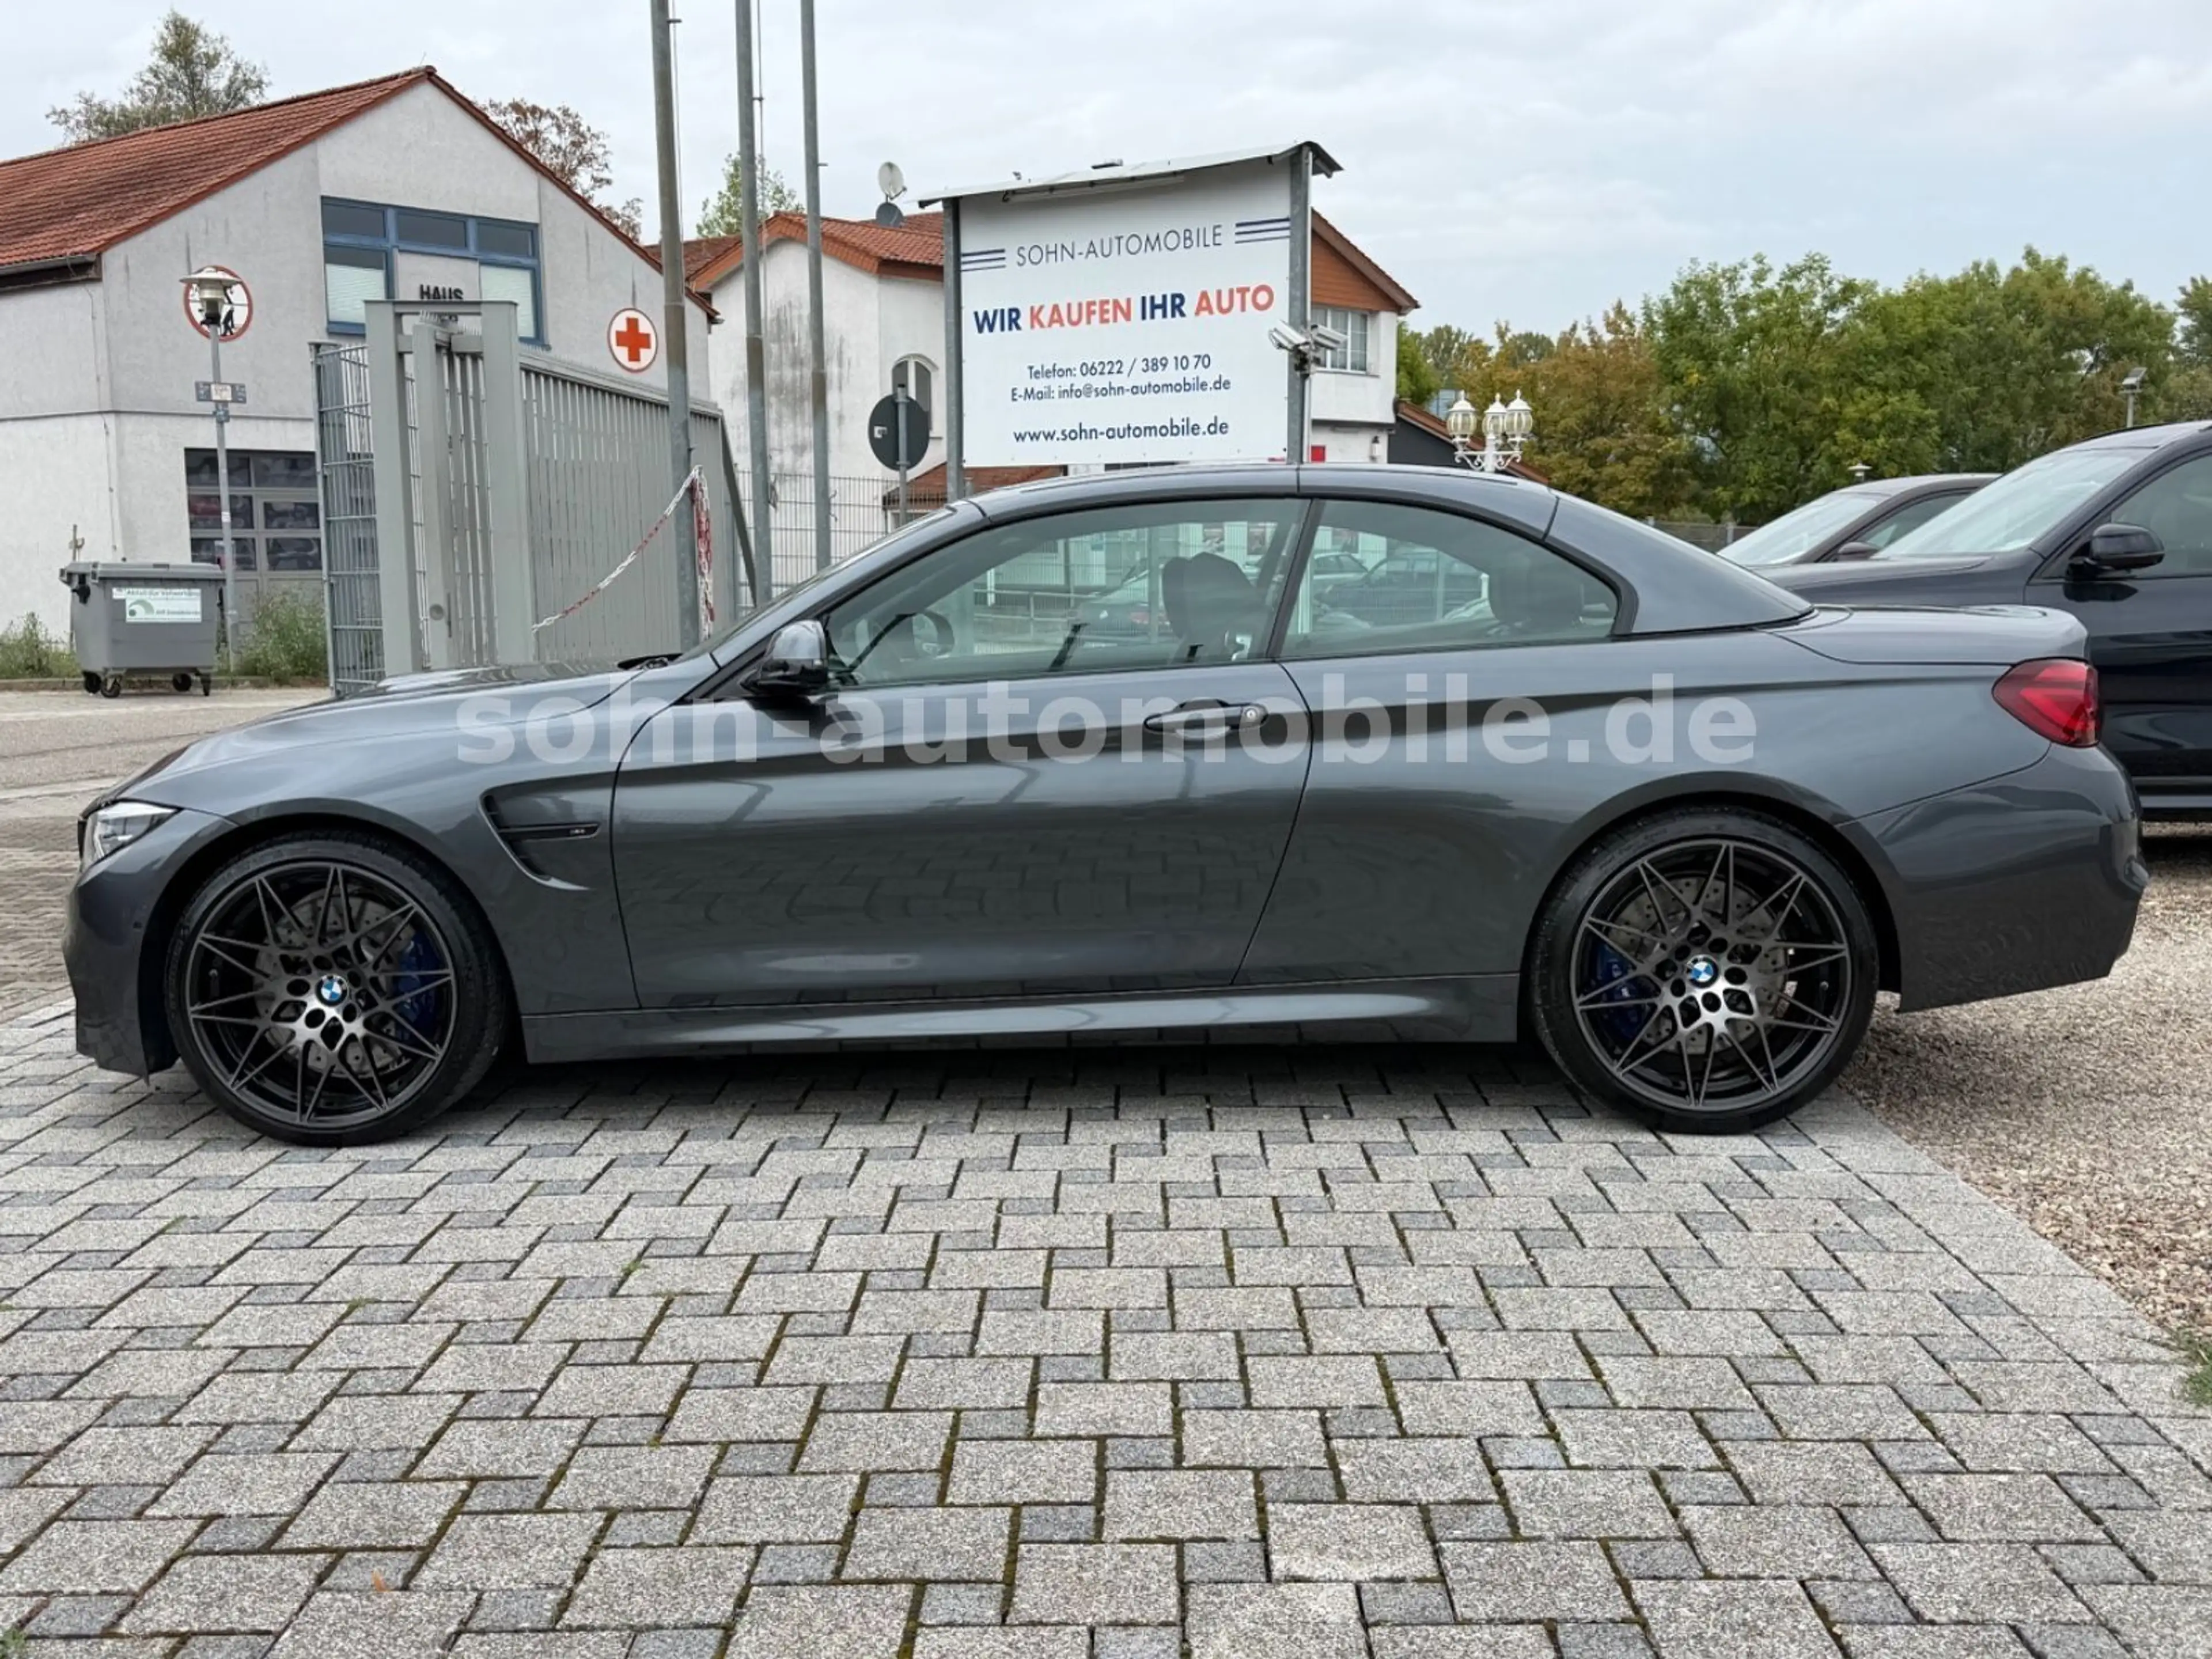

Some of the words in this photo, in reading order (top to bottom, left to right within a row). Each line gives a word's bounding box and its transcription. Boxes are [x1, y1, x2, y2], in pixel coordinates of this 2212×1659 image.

[1017, 225, 1222, 266] SOHN-AUTOMOBILE
[974, 308, 1022, 334] WIR
[1030, 297, 1131, 329] KAUFEN
[1141, 293, 1187, 320] IHR
[1195, 285, 1274, 316] AUTO
[1028, 363, 1076, 379] Telefon:
[1080, 359, 1123, 376] 06222
[1127, 358, 1137, 377] /
[1142, 357, 1169, 373] 389
[1174, 355, 1189, 370] 10
[1193, 354, 1211, 370] 70
[1011, 385, 1054, 402] E-Mail:
[1058, 374, 1230, 399] info@sohn-automobile.de
[1014, 416, 1228, 442] www.sohn-automobile.de
